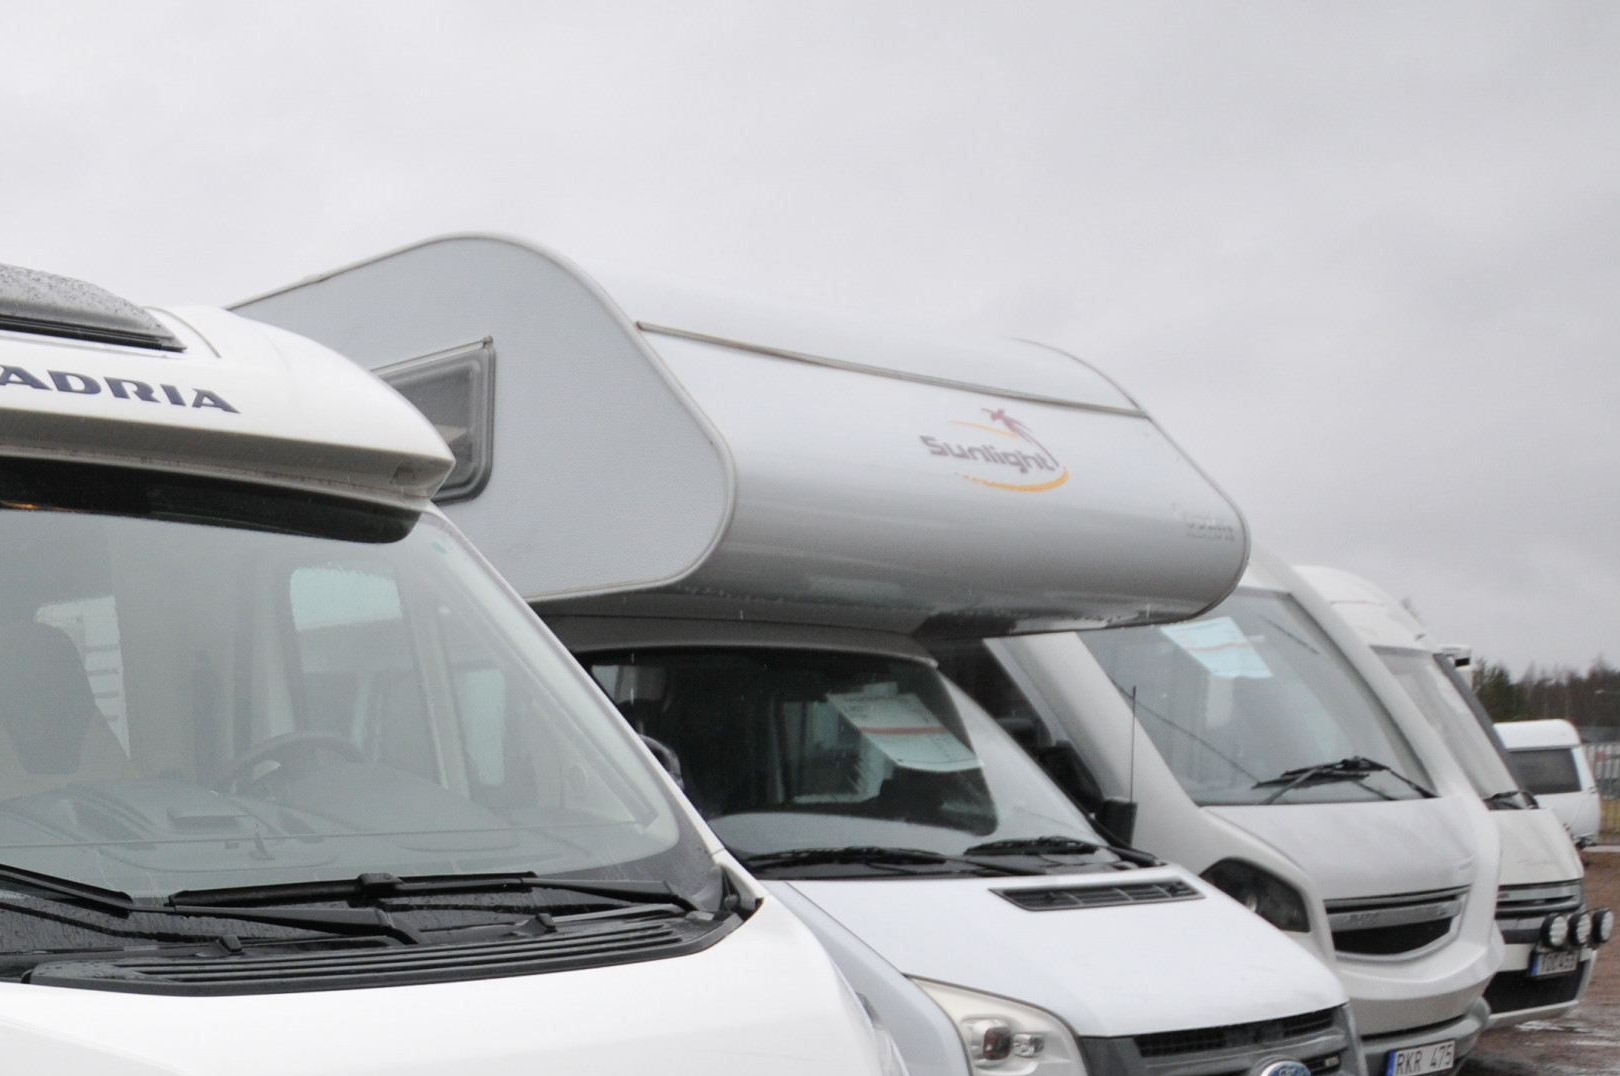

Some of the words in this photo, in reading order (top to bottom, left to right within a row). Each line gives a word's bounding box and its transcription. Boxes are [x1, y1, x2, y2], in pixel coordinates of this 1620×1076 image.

[919, 435, 1056, 474] Sunlight
[1396, 1050, 1422, 1075] RKR
[1430, 1044, 1453, 1068] 475
